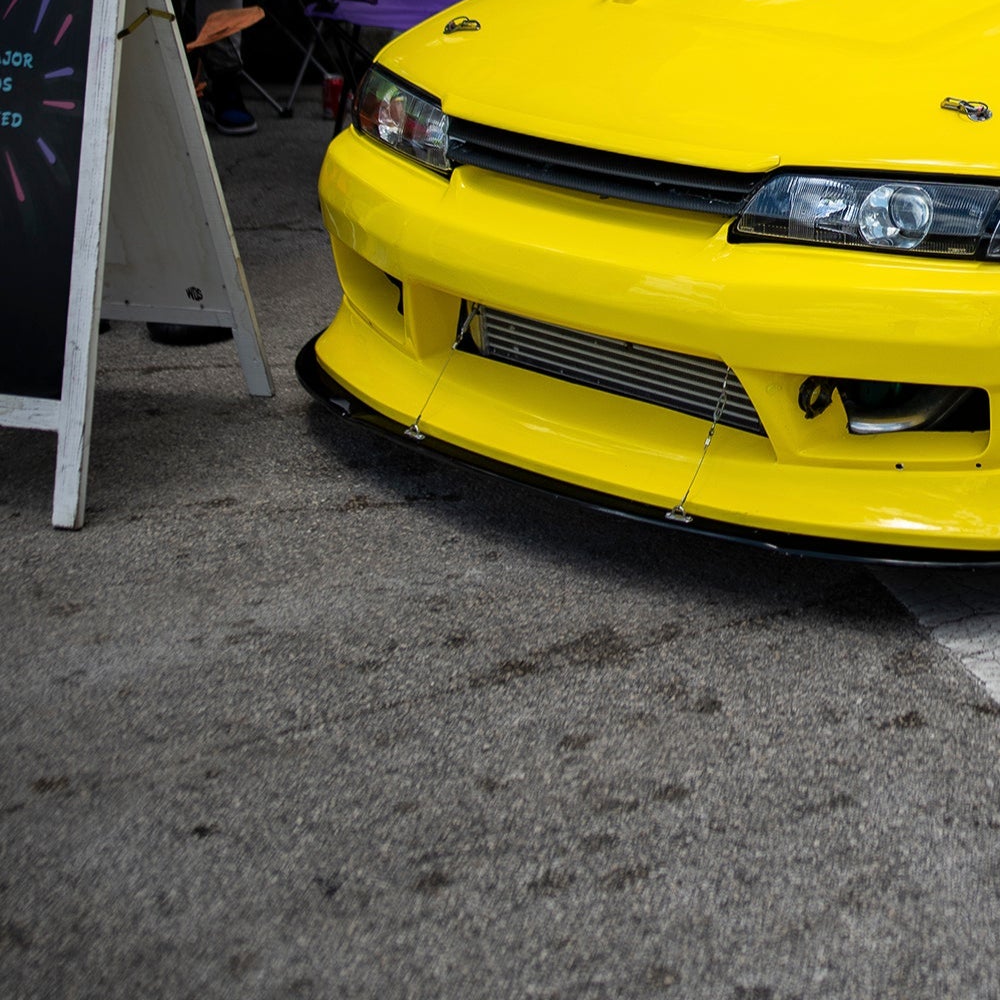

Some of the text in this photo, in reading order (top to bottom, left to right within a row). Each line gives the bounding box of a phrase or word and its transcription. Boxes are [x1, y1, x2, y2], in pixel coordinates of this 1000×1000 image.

[0, 49, 34, 69] JOR
[0, 76, 13, 93] S
[0, 109, 23, 128] ED
